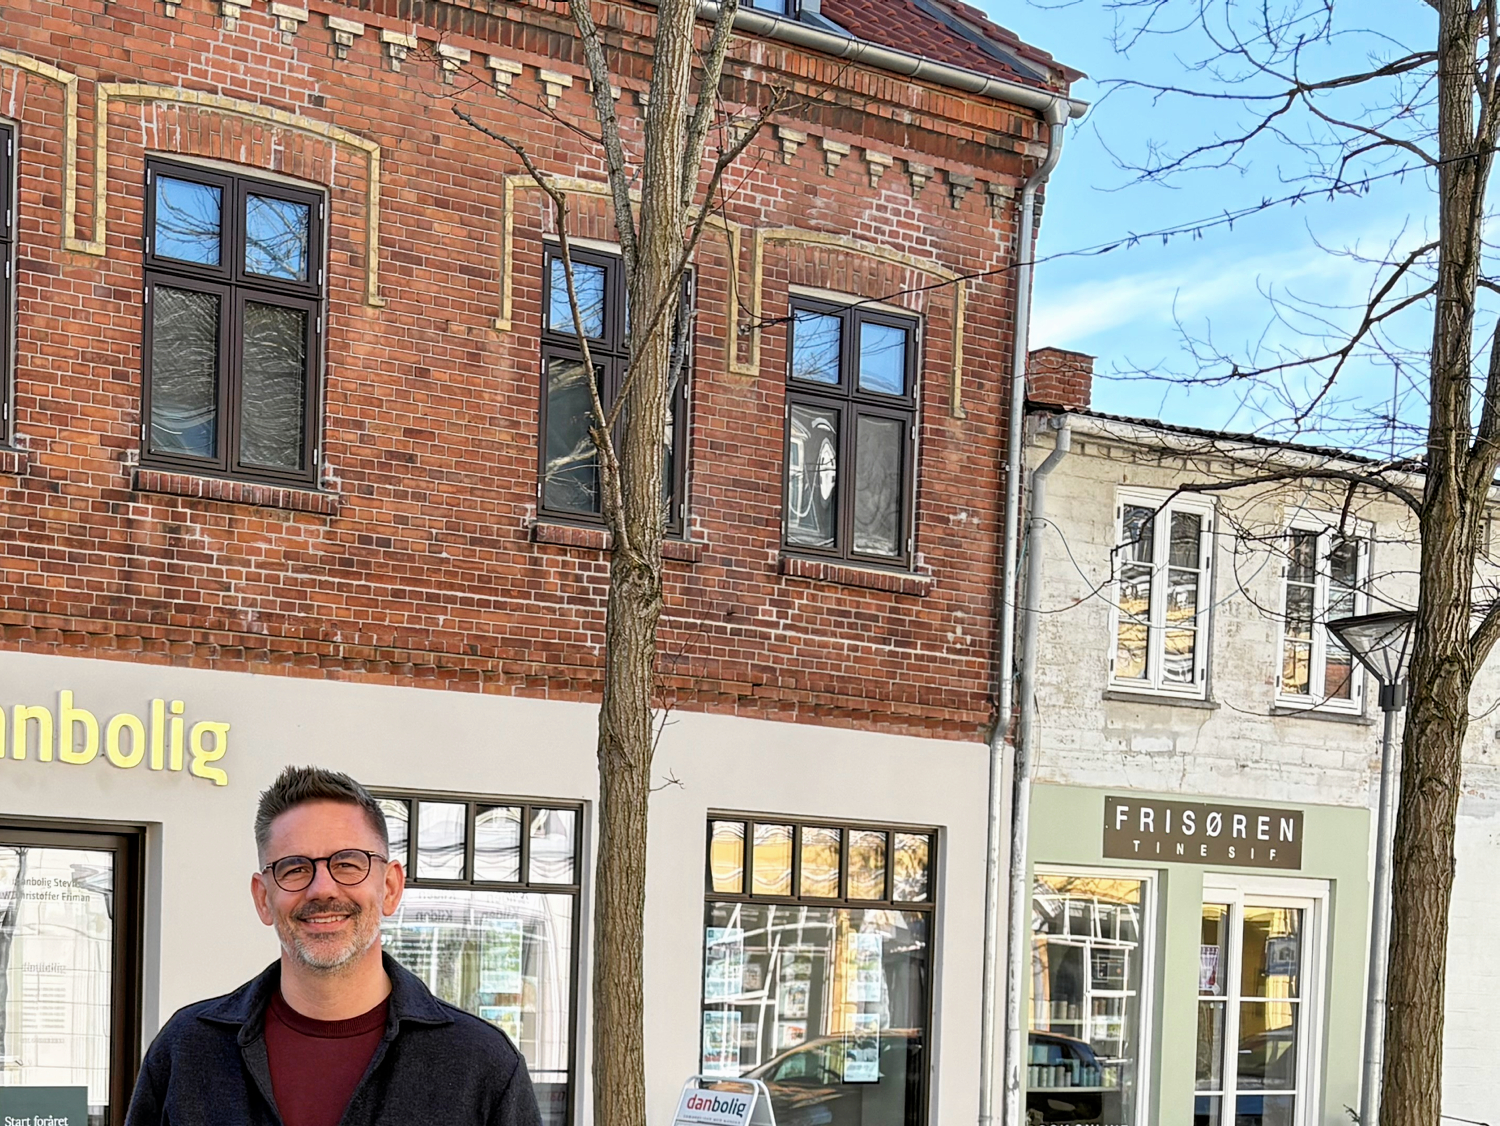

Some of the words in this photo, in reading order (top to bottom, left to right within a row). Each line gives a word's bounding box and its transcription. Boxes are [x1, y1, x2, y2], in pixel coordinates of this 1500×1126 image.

[1115, 804, 1295, 843] FRISØREN
[1133, 840, 1208, 857] TINE
[1228, 846, 1277, 861] SIF
[686, 1093, 747, 1119] danbolig
[33, 1114, 69, 1126] foråret
